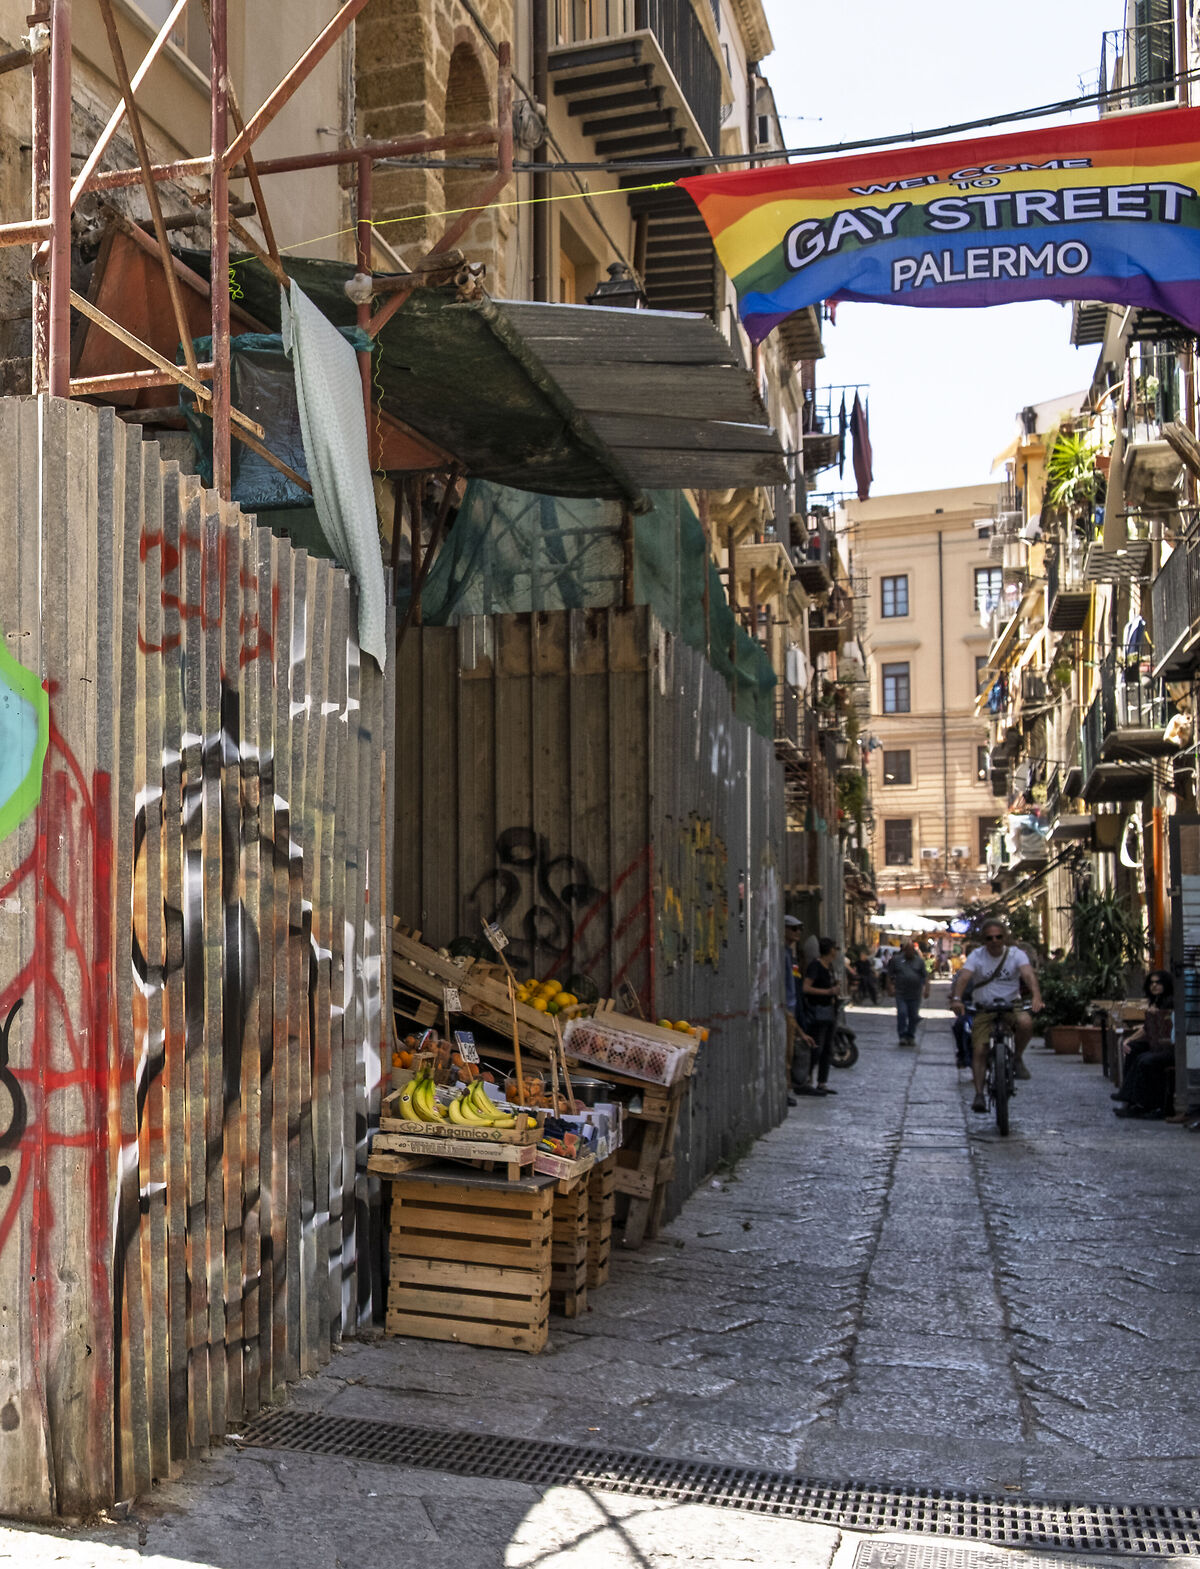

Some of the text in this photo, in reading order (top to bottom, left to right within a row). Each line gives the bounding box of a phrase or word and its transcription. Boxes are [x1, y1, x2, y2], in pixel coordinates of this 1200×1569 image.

[850, 157, 1092, 196] WELCOME
[952, 176, 1001, 191] TO
[785, 182, 1196, 271] GAY STREET
[891, 240, 1090, 292] PALERMO
[425, 1124, 489, 1140] Fungamico
